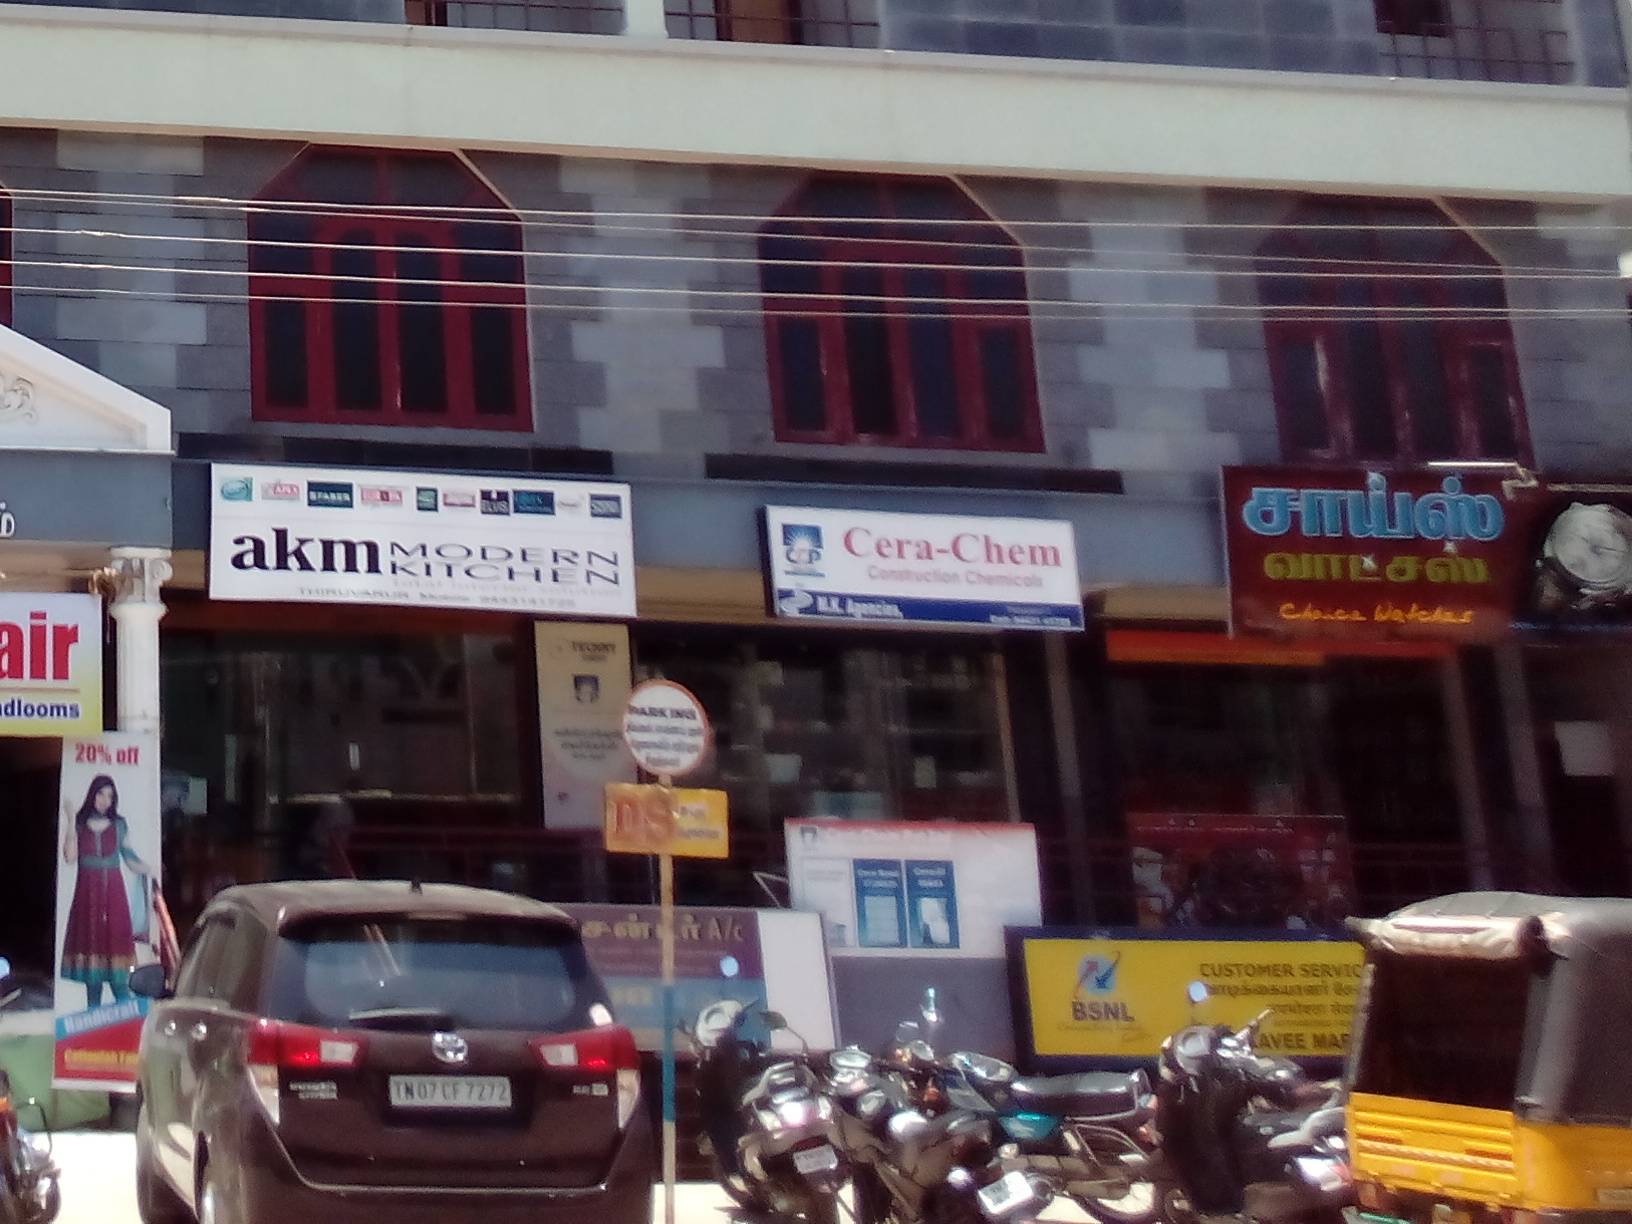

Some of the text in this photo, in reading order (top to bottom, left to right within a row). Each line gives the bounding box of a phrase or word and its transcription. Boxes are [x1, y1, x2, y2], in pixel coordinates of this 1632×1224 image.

[230, 527, 619, 574] akm MODERN
[842, 526, 1062, 567] Cera-Chem
[390, 561, 620, 586] KITCHEN
[75, 743, 138, 765] 20% off
[1200, 963, 1295, 977] CUSTOMER
[1071, 1001, 1135, 1022] BSNL
